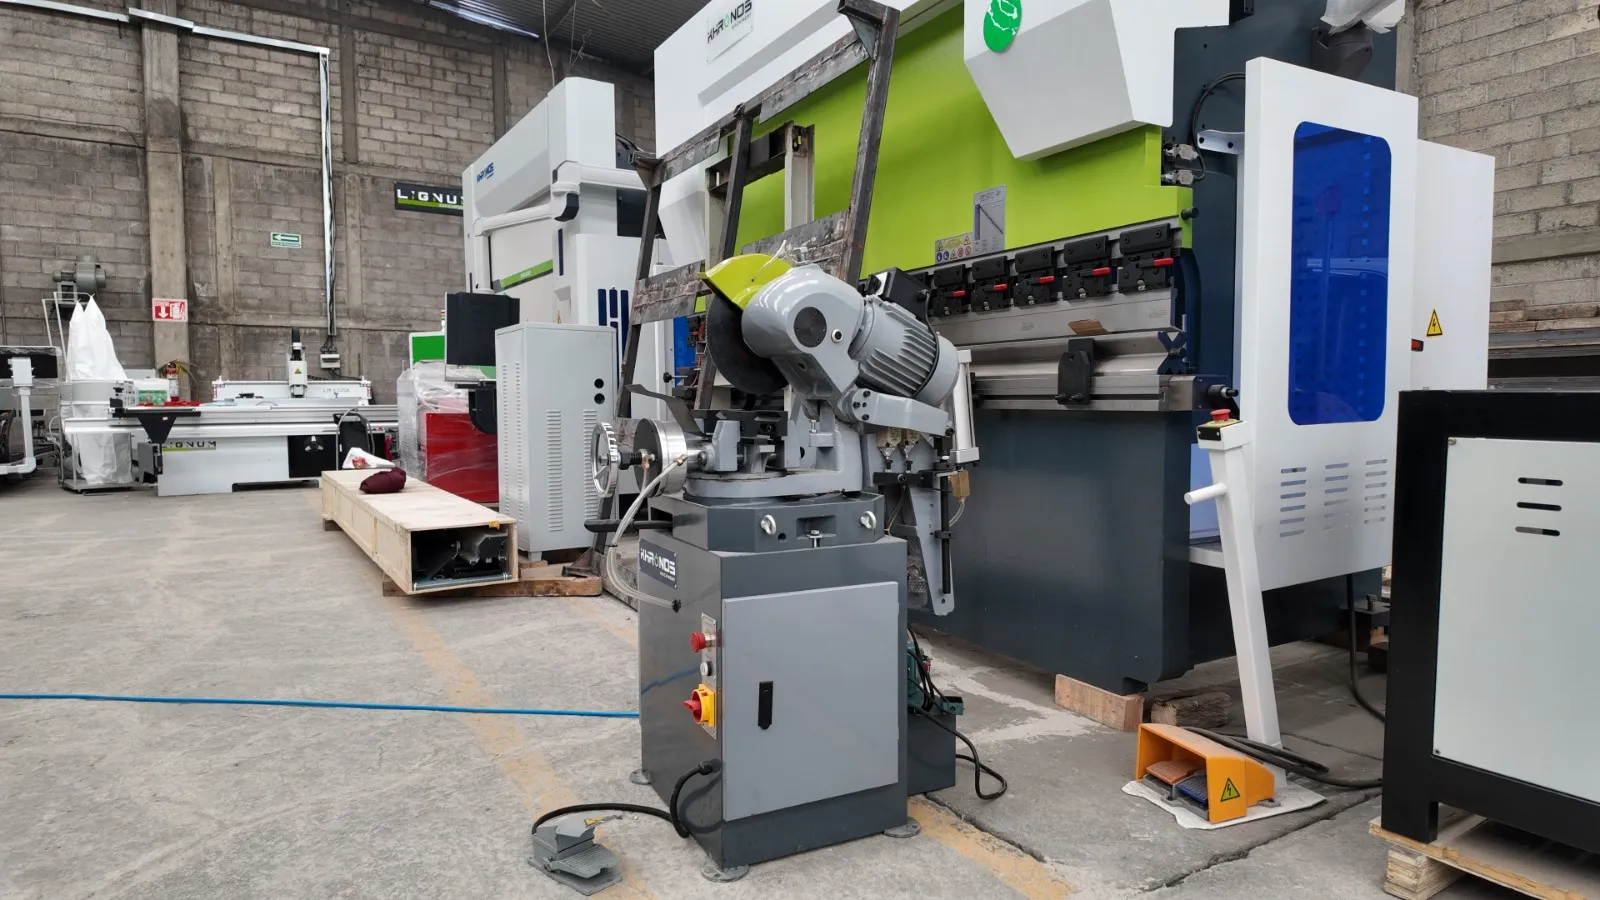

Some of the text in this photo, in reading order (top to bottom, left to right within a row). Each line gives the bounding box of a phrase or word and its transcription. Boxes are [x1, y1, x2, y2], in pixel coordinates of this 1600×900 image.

[707, 0, 752, 44] KHRONOS
[396, 188, 464, 205] LIGNU
[640, 547, 676, 576] KHRONOS
